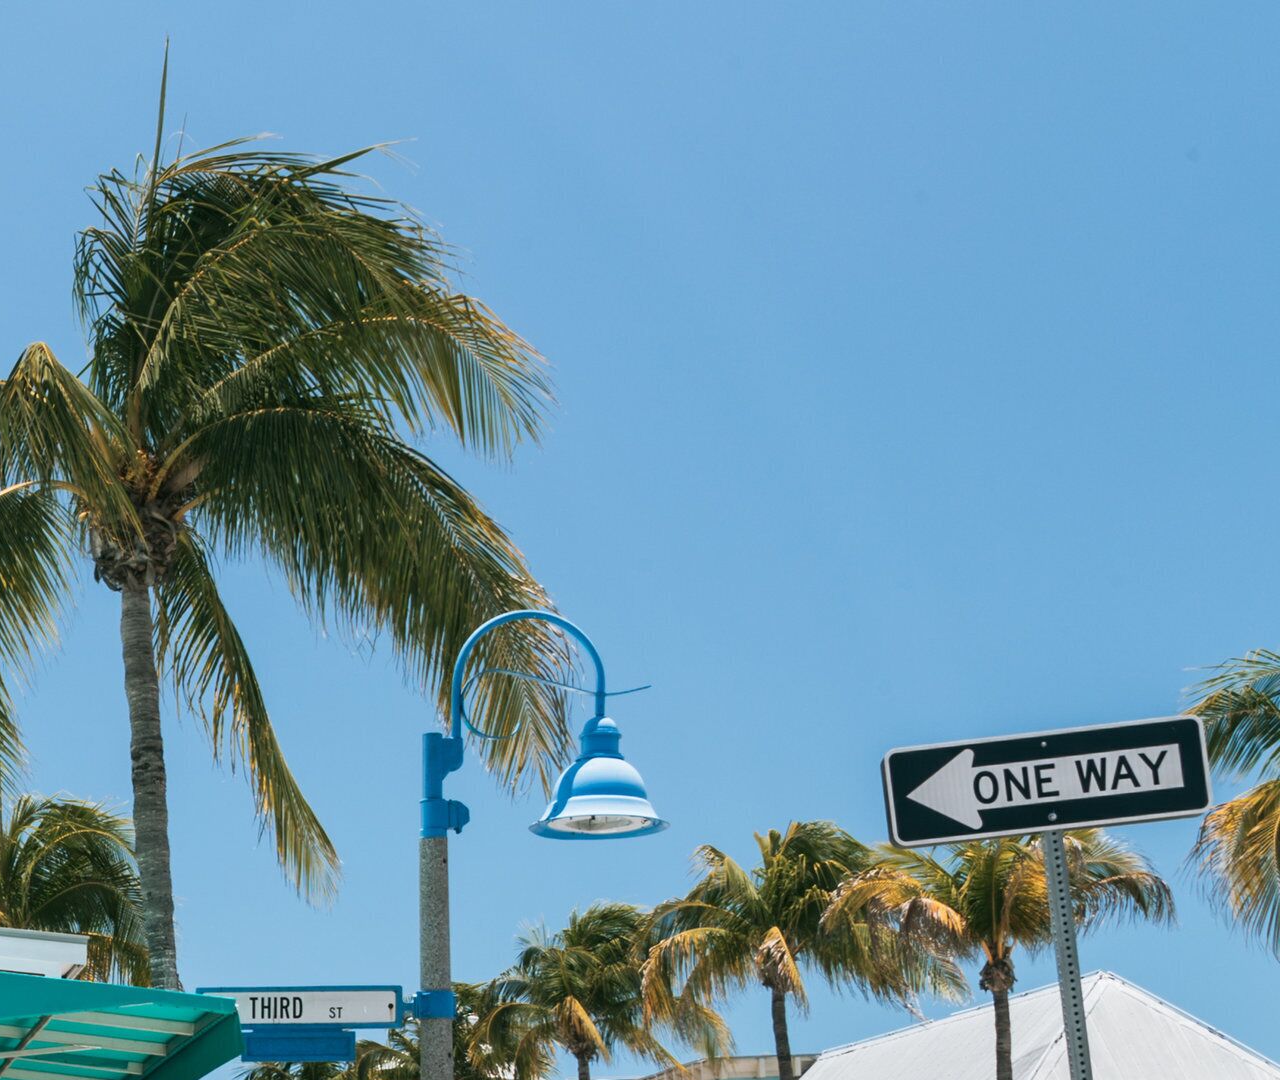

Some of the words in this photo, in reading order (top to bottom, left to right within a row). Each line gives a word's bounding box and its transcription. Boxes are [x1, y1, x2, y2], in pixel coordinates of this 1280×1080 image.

[973, 763, 1060, 804] ONE
[1074, 750, 1168, 793] WAY
[249, 997, 303, 1019] THIRD
[328, 1007, 343, 1019] ST
